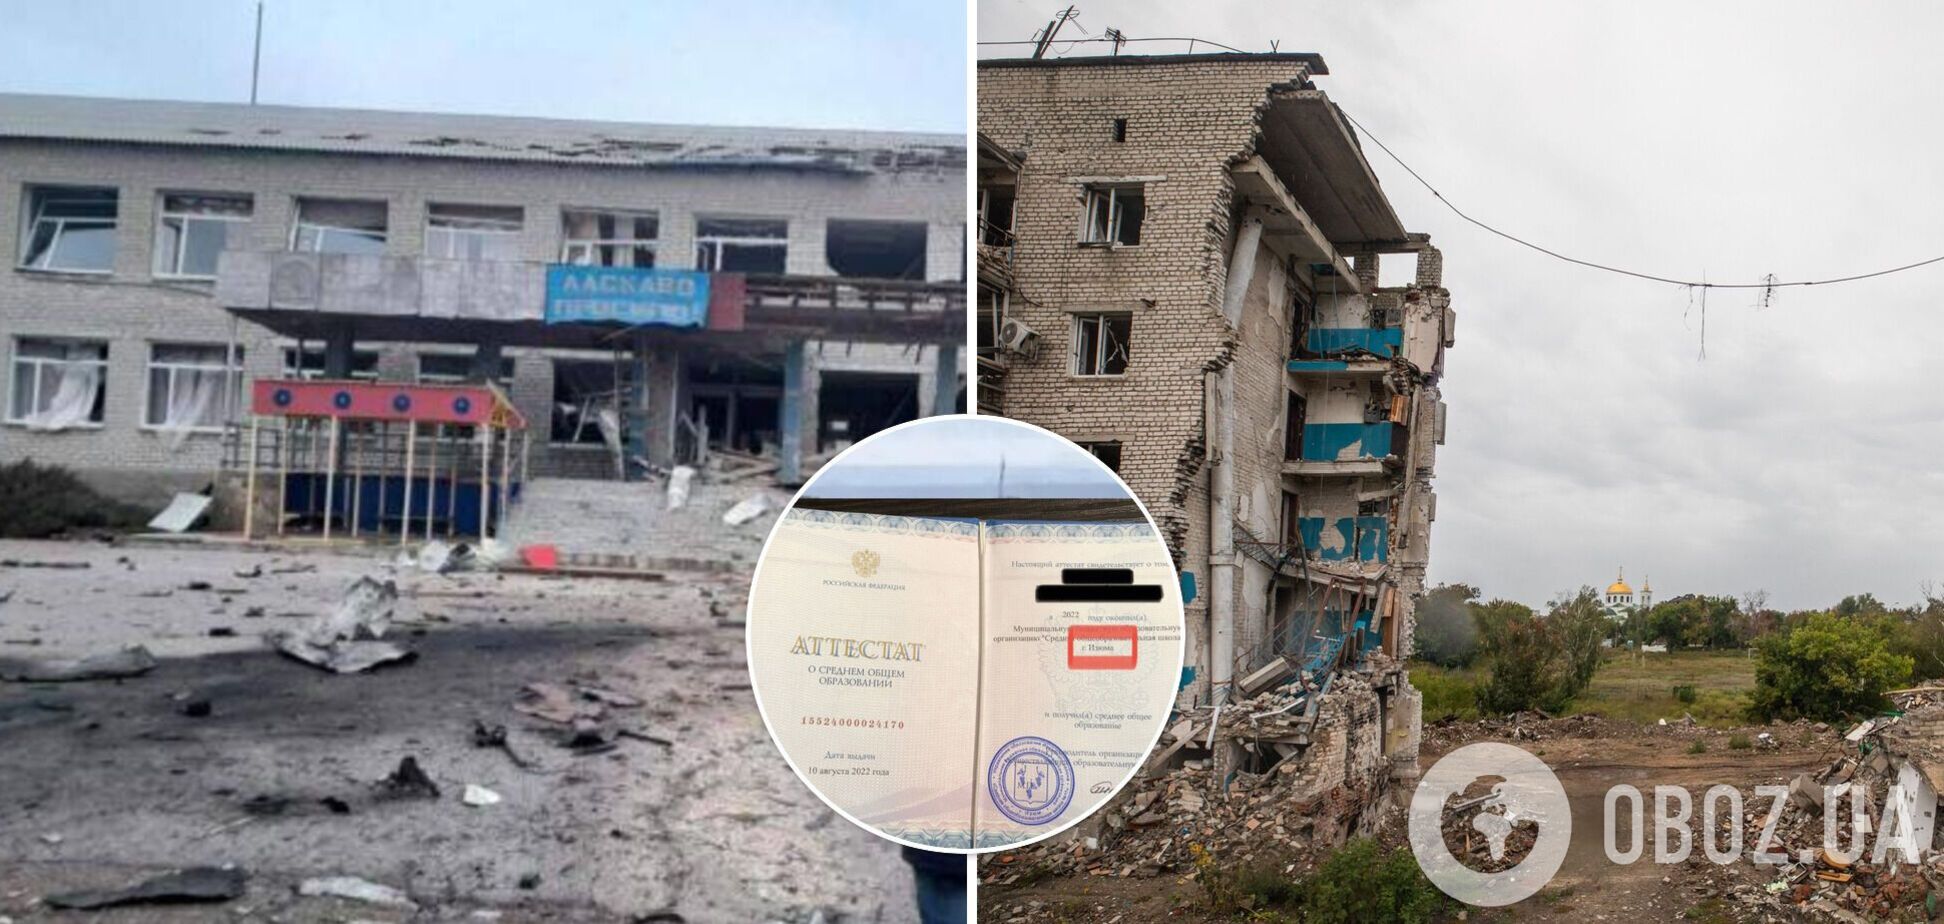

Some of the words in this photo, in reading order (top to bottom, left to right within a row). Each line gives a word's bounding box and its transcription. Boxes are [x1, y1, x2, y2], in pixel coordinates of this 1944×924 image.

[1011, 560, 1053, 569] Настоящий
[823, 580, 866, 588] РОССИЙСКАЯ
[868, 583, 906, 591] ФЕДЕРАЦИЯ
[1013, 626, 1072, 635] Муниципальну
[1041, 635, 1070, 643] "Средн
[790, 636, 925, 662] АТТЕСТАТ
[808, 665, 816, 673] О
[819, 666, 865, 677] СРЕДНЕМ
[868, 669, 905, 678] ОБЩЕМ
[819, 676, 893, 688] ОБРАЗОВАНИИ
[1094, 713, 1125, 721] среднее
[1127, 712, 1152, 720] общее
[1074, 722, 1122, 730] образование
[824, 751, 845, 760] Дата
[1098, 750, 1143, 759] организаци
[808, 767, 818, 775] 10
[820, 768, 850, 777] августа
[851, 767, 871, 776] 2022
[873, 769, 890, 777] года
